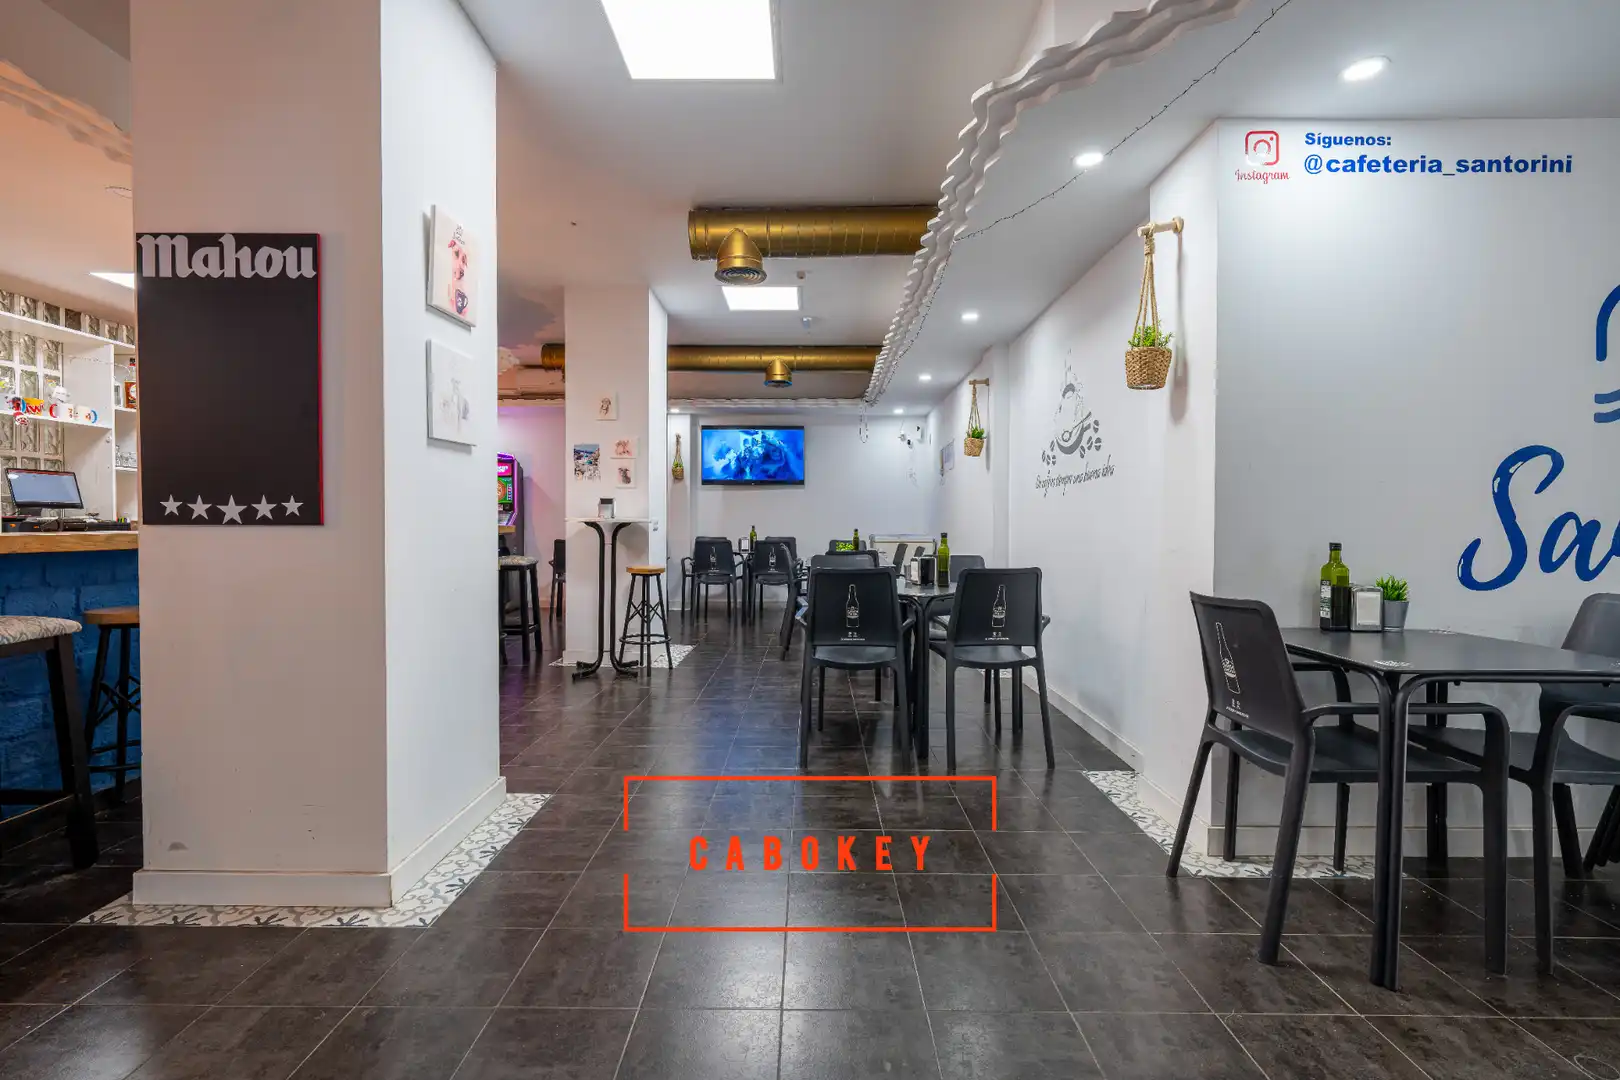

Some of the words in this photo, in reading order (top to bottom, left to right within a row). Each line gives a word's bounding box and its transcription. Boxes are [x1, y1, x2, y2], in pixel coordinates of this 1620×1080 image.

[1304, 131, 1392, 150] Síguenos:
[1303, 153, 1574, 175] @cafeteria_santorini
[1234, 168, 1291, 185] Instagram
[137, 234, 317, 279] Mahou
[1457, 444, 1620, 591] Sa
